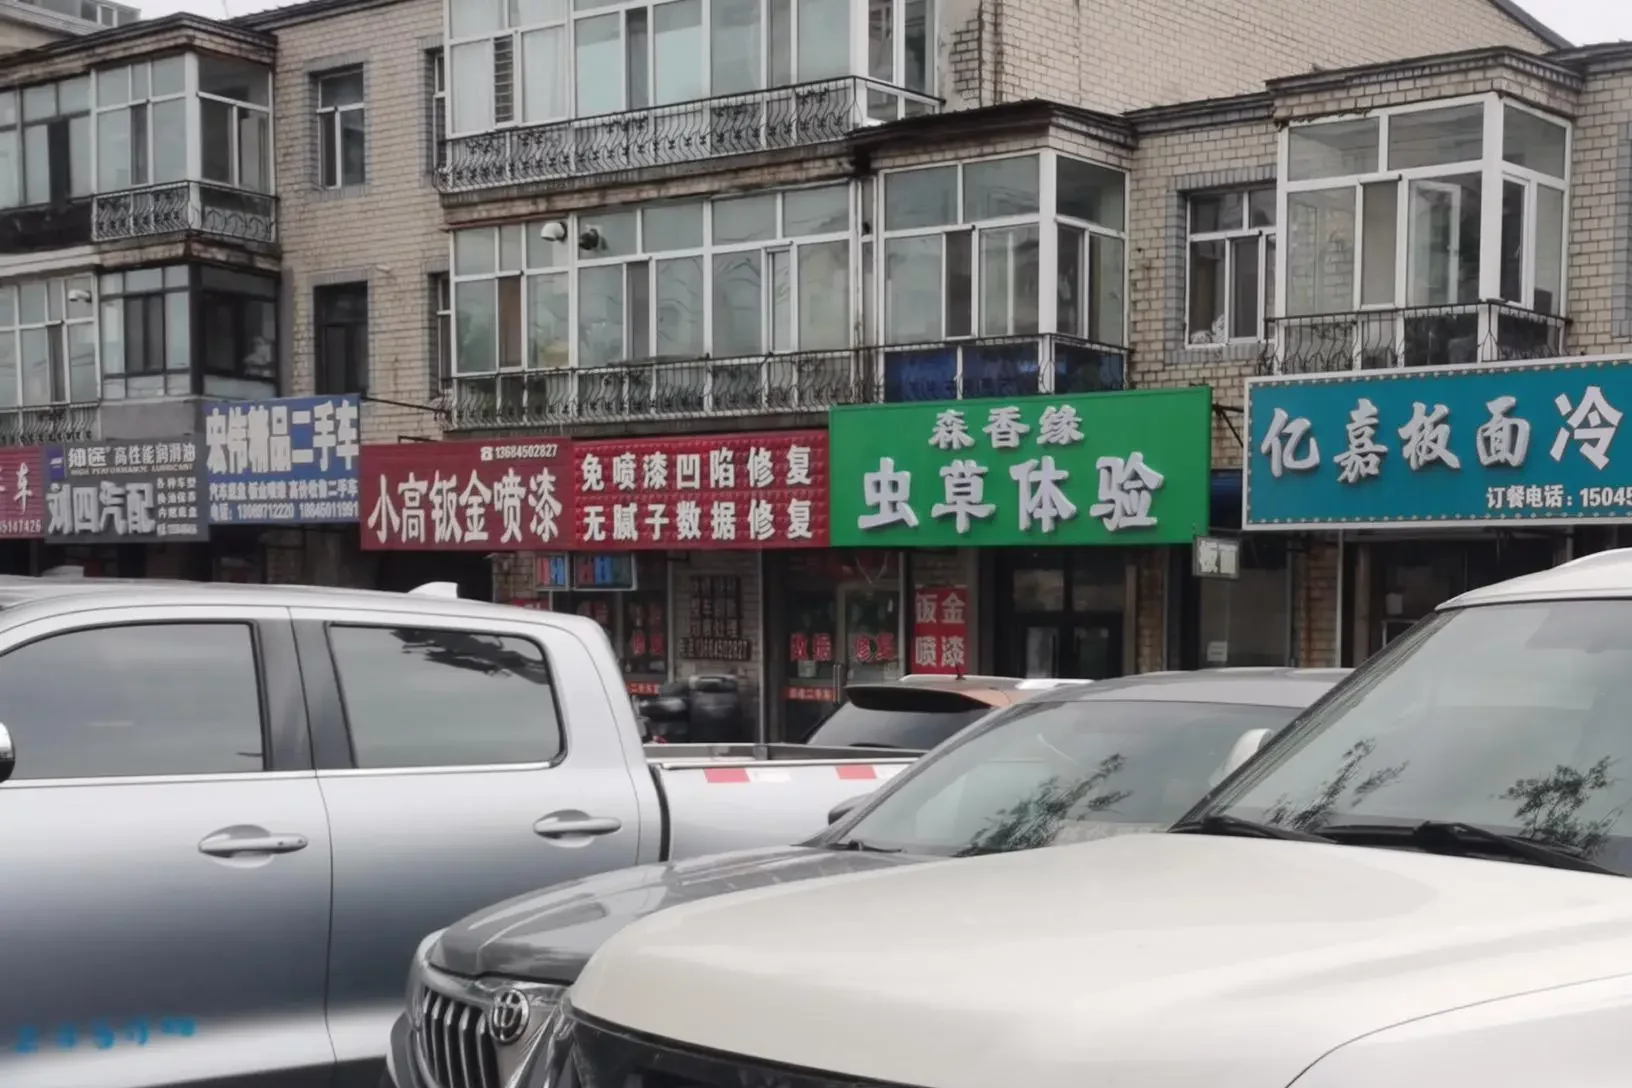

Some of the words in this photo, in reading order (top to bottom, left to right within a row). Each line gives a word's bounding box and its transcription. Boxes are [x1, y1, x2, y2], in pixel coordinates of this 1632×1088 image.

[928, 404, 1085, 451] 森香缘
[495, 443, 559, 461] 13684502827
[580, 444, 813, 493] 免喷漆凹陷修复
[46, 480, 156, 536] 刘四汽配
[367, 466, 562, 546] 小高钣金喷漆
[857, 451, 1165, 534] 虫草体验
[581, 497, 814, 543] 无腻子数据修复
[915, 592, 967, 625] 钣金
[914, 634, 966, 668] 喷漆
